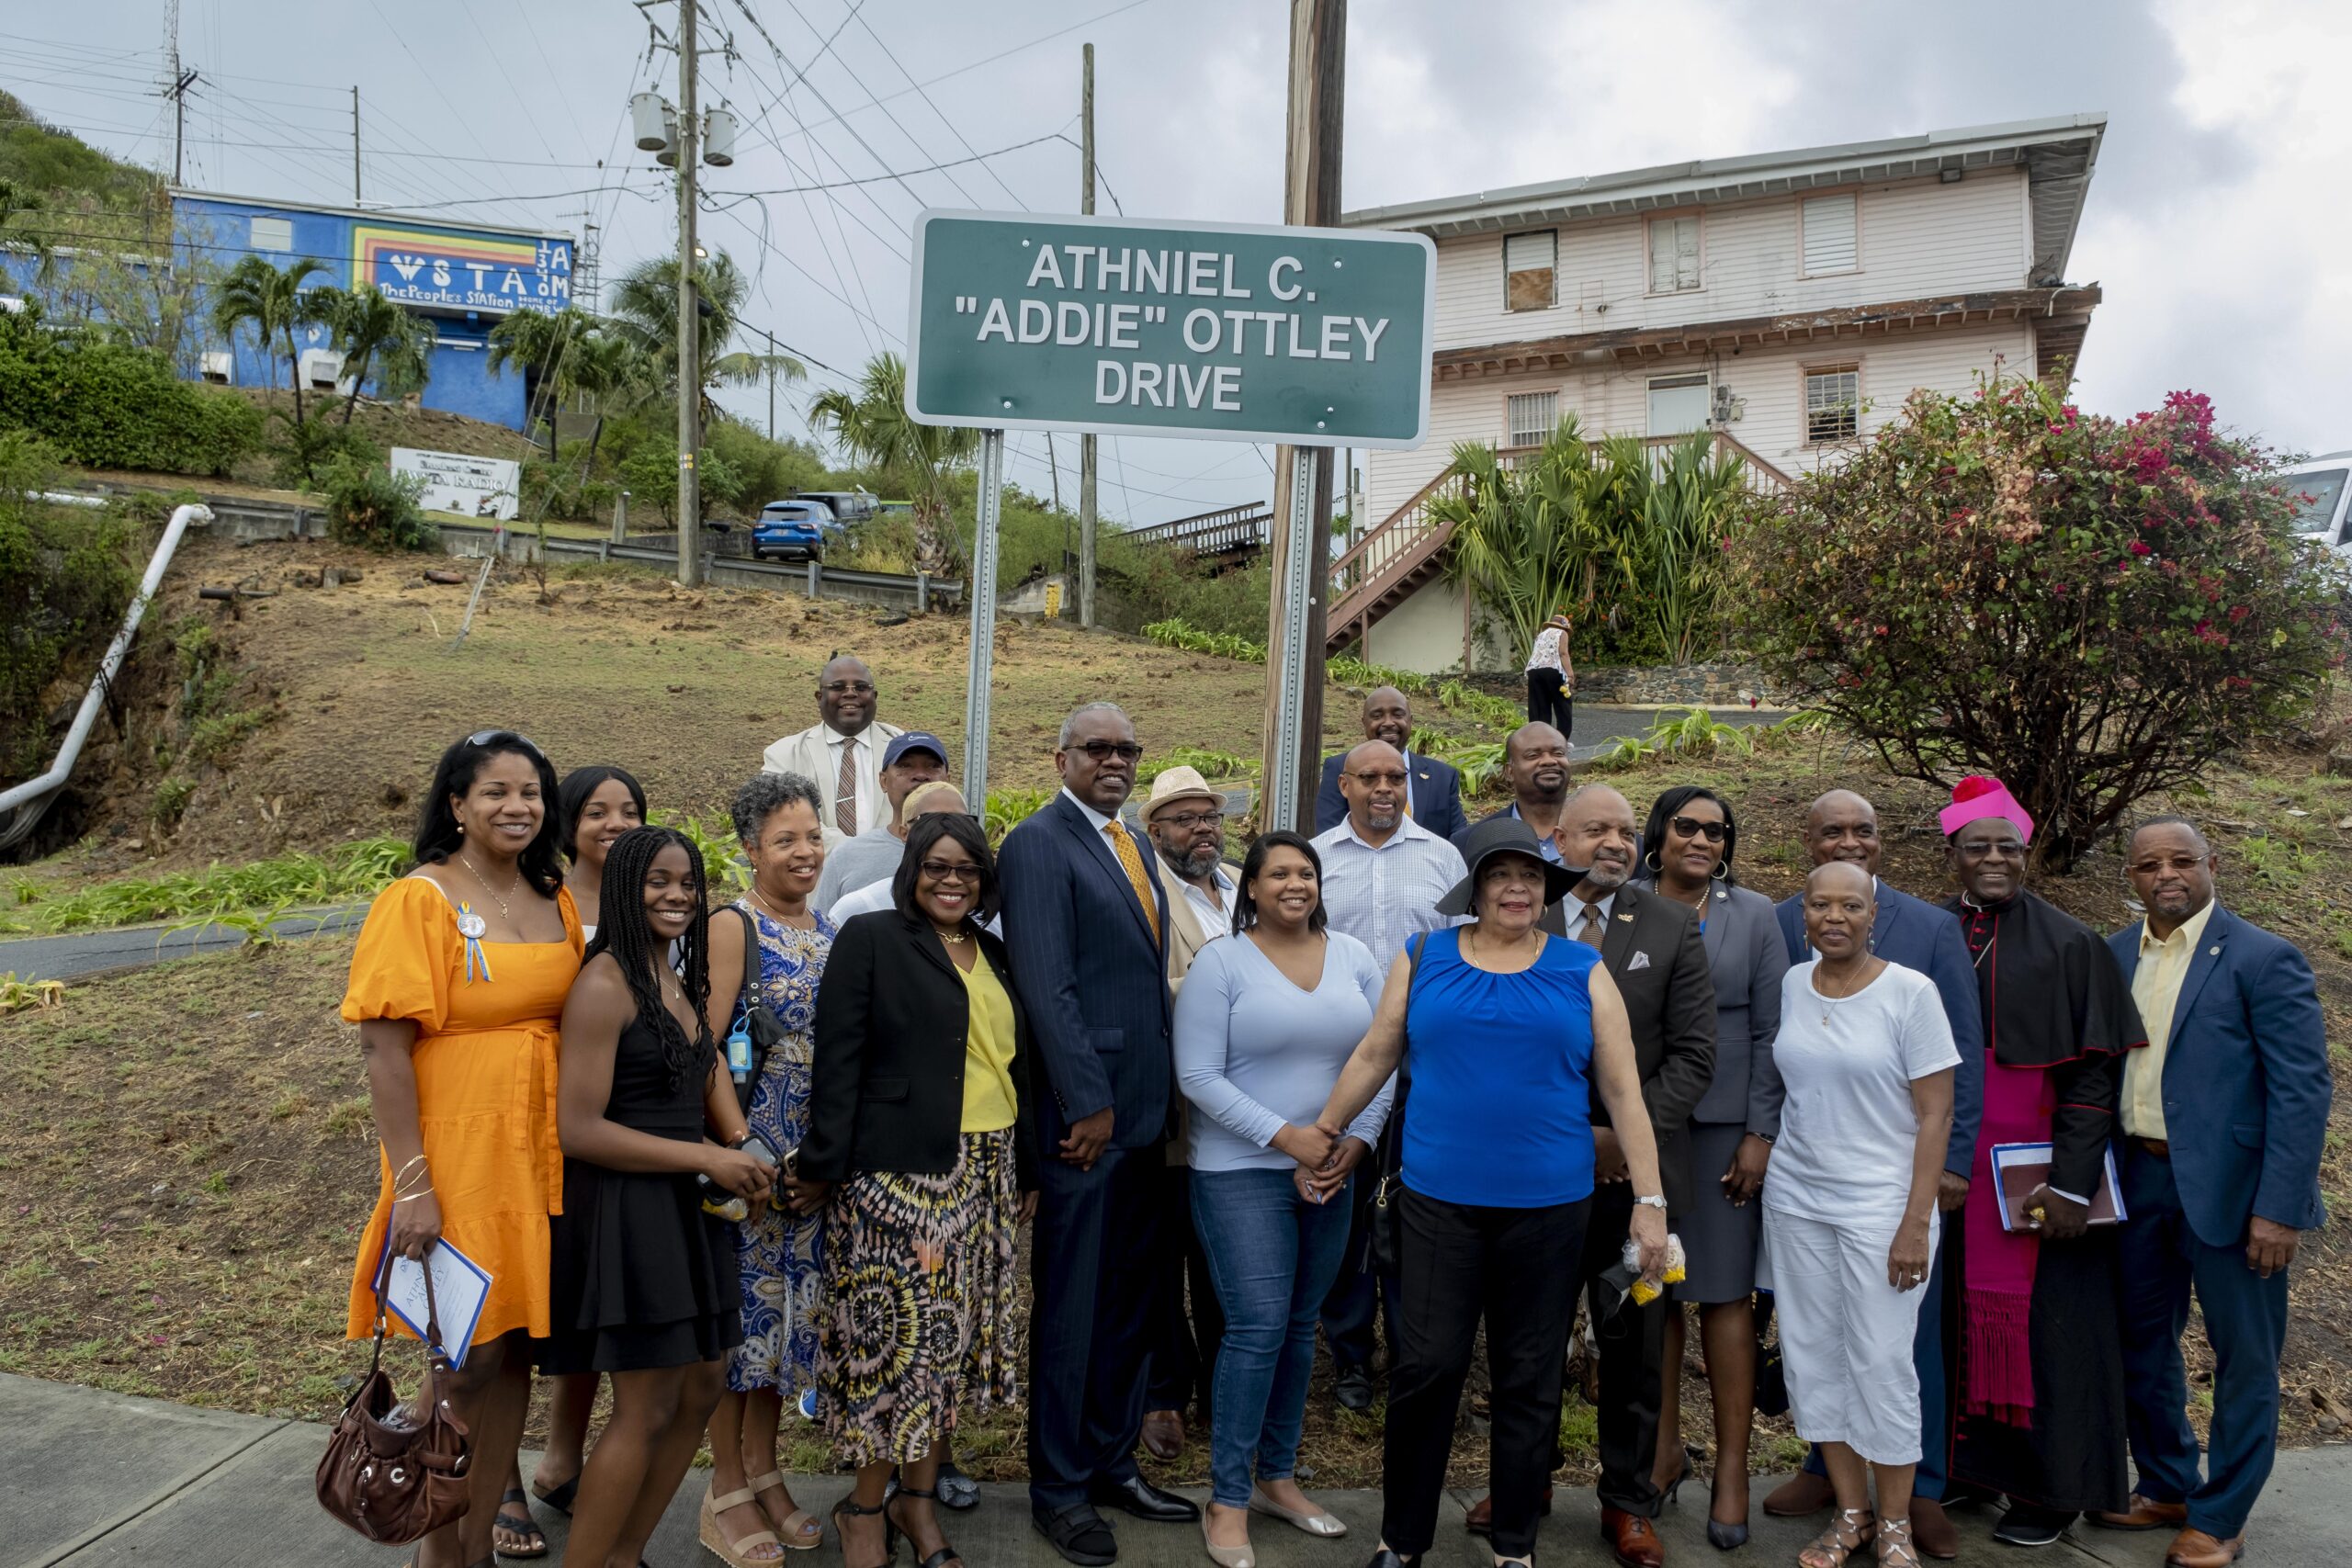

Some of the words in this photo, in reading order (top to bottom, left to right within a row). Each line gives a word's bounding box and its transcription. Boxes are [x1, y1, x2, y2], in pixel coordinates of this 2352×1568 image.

[390, 254, 527, 295] WSTA
[1026, 243, 1250, 299] ATHNIEL
[1268, 255, 1316, 302] C.
[956, 296, 1166, 349] "ADDIE"
[1182, 308, 1390, 362] OTTLEY
[1095, 359, 1242, 412] DRIVE
[454, 475, 505, 491] RADIO
